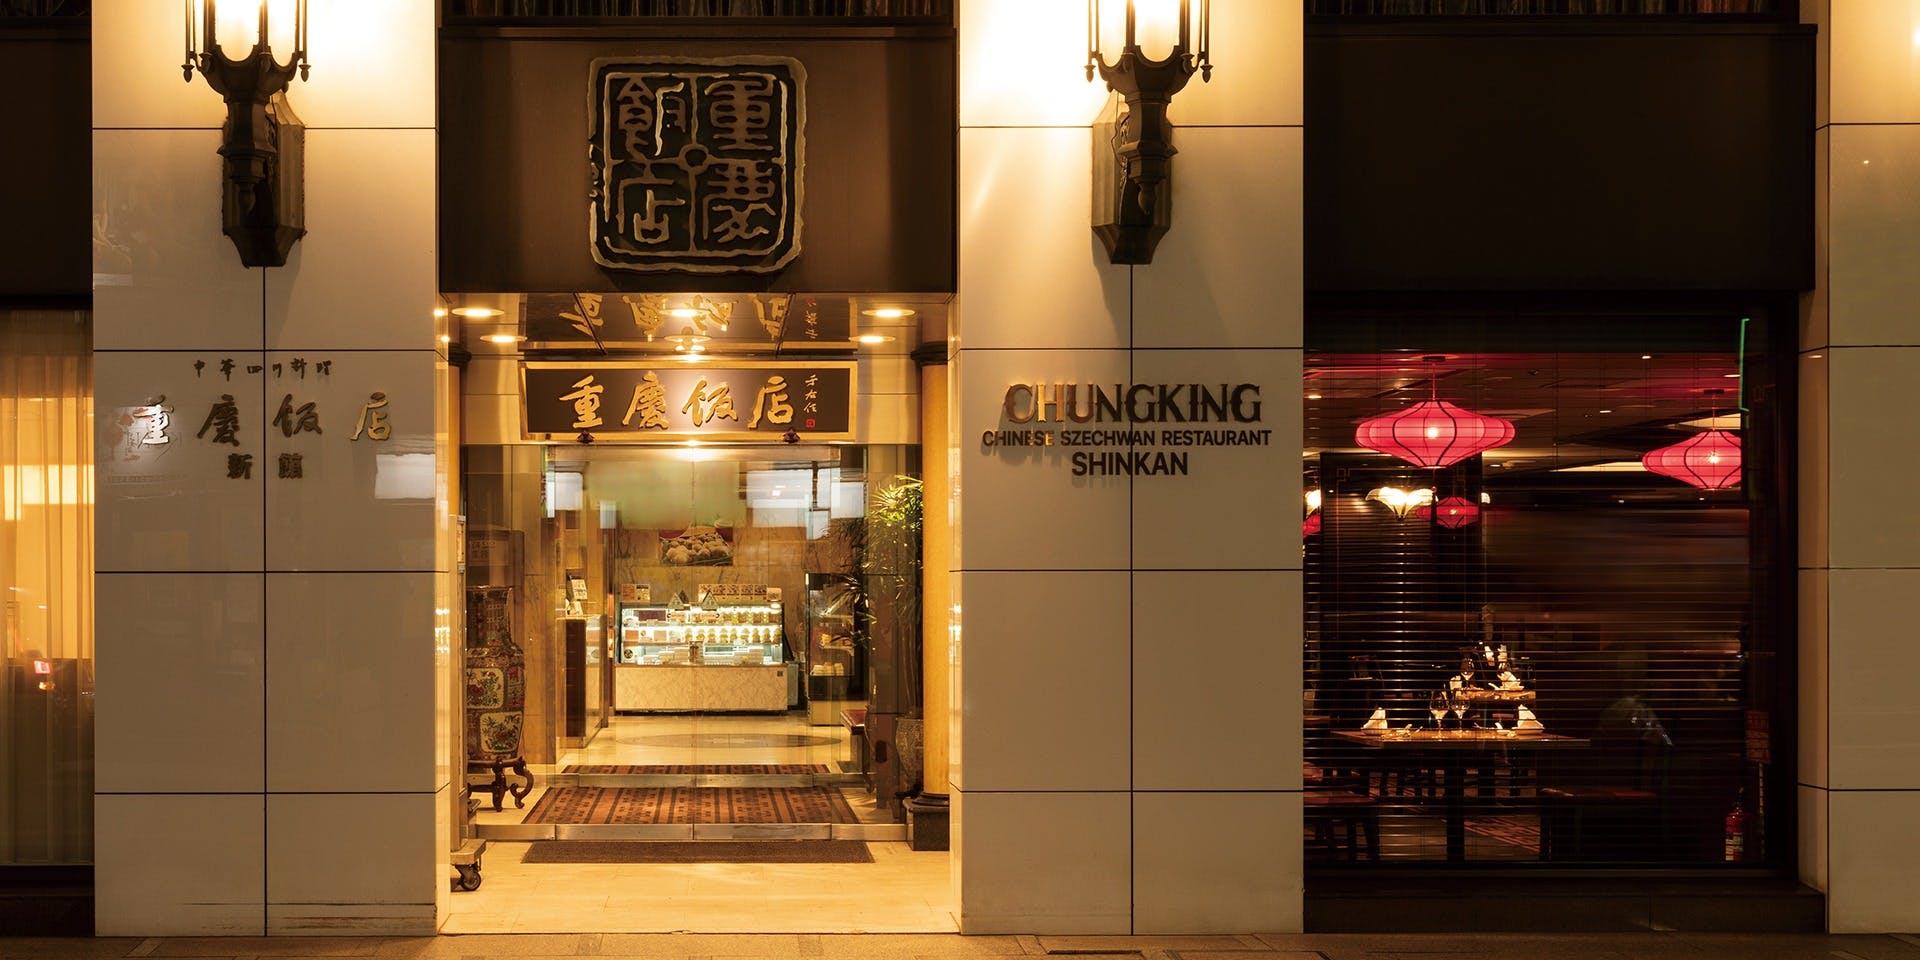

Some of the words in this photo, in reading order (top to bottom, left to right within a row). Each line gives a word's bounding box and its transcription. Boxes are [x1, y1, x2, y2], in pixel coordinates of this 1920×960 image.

[193, 358, 333, 382] 中華四川料理
[559, 371, 794, 430] 重慶飯店
[1003, 383, 1262, 424] CHUNGKING
[132, 391, 392, 447] 重慶飯店
[982, 430, 1055, 447] CHINESE
[1061, 430, 1156, 447] SZECHWAN
[1162, 430, 1272, 447] RESTAURANT
[1071, 451, 1189, 476] SHINKAN
